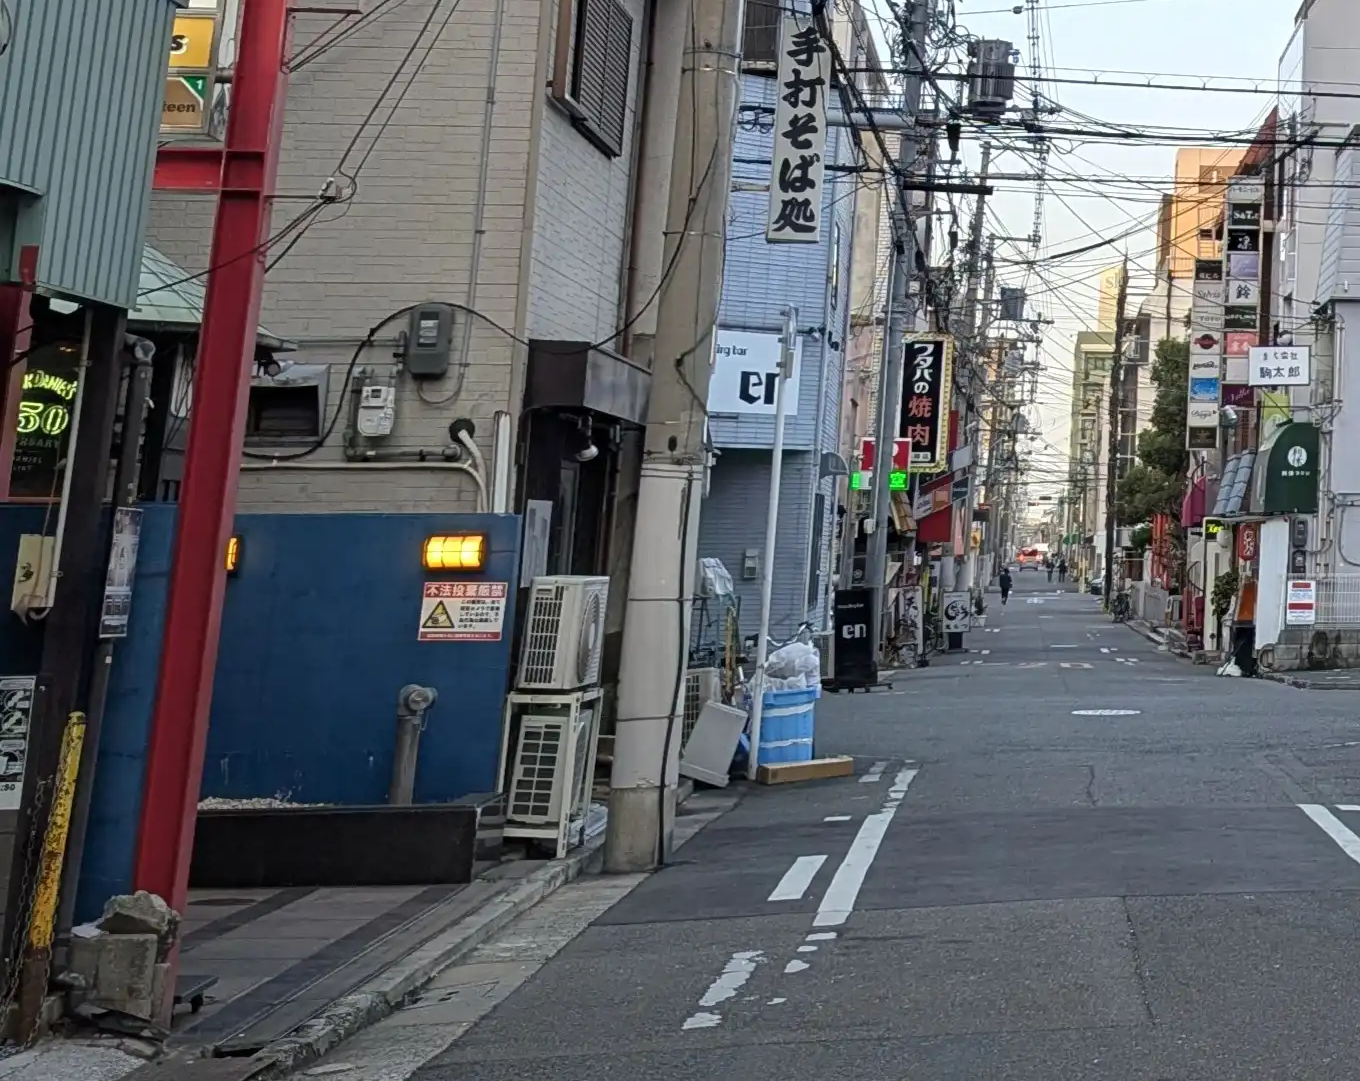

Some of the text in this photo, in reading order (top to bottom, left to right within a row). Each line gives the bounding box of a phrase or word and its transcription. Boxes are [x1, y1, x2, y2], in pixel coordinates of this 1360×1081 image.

[772, 26, 827, 234] 手打そば処
[907, 344, 935, 446] フタバの焼肉
[1259, 366, 1301, 379] 駒太郎
[842, 624, 866, 639] en
